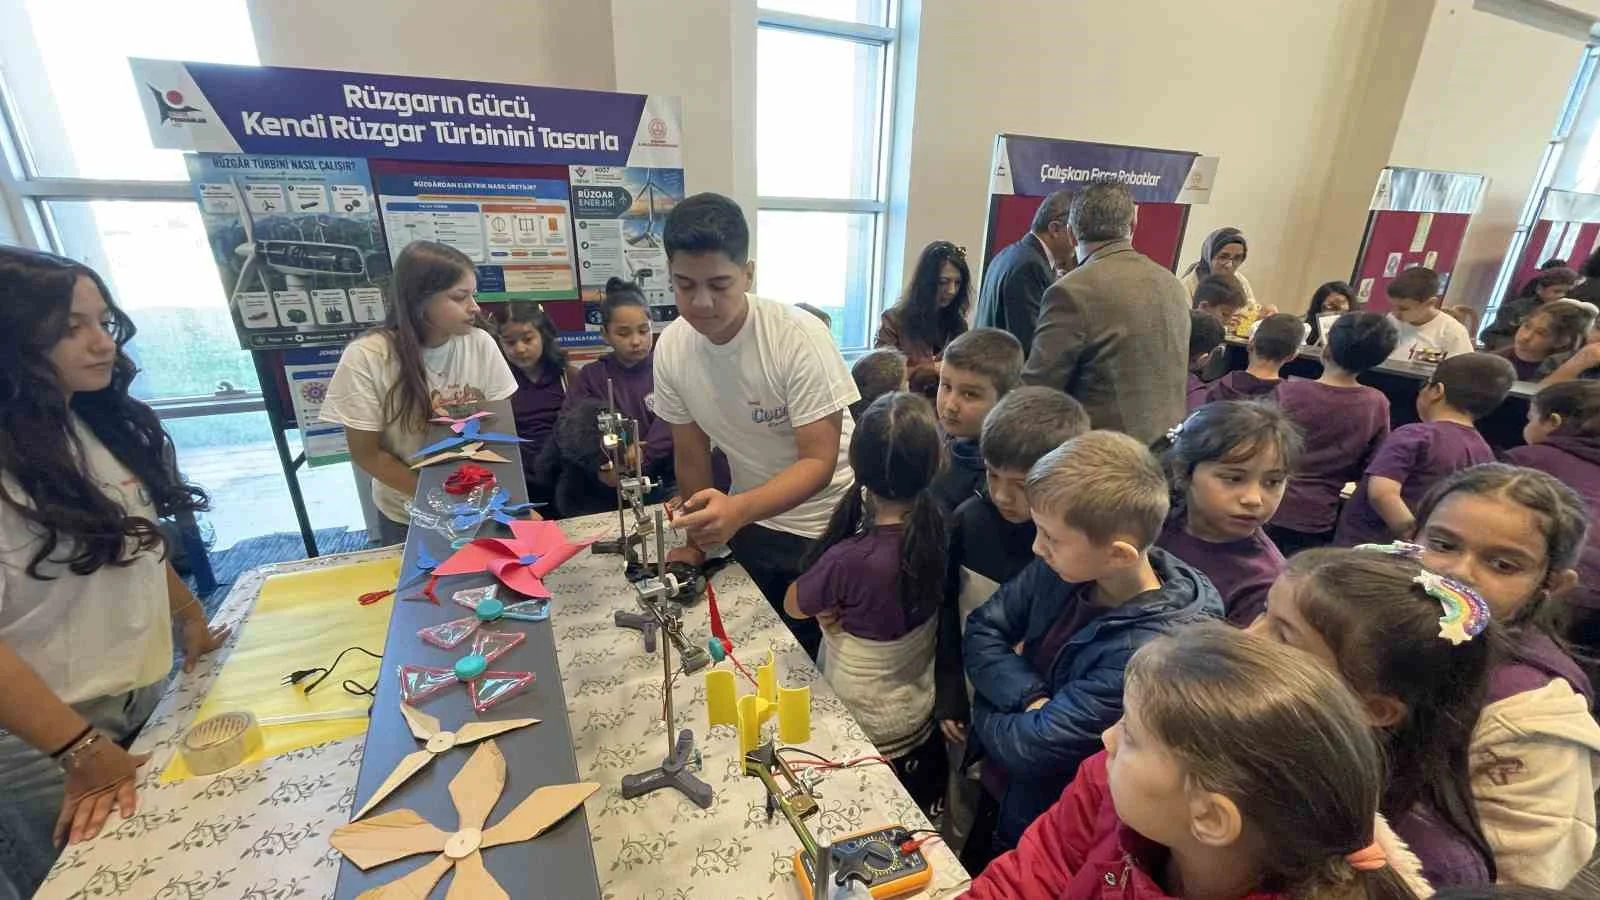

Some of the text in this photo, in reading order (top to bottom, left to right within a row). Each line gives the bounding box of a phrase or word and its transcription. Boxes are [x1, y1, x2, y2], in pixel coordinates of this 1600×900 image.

[343, 84, 536, 121] Rüzgarın Gücü,
[241, 111, 619, 152] Kendi Rüzgar Türbinini Tasarla
[291, 159, 317, 170] NASIL
[1040, 163, 1090, 183] Çalışkan
[1118, 170, 1161, 187] Robotlar
